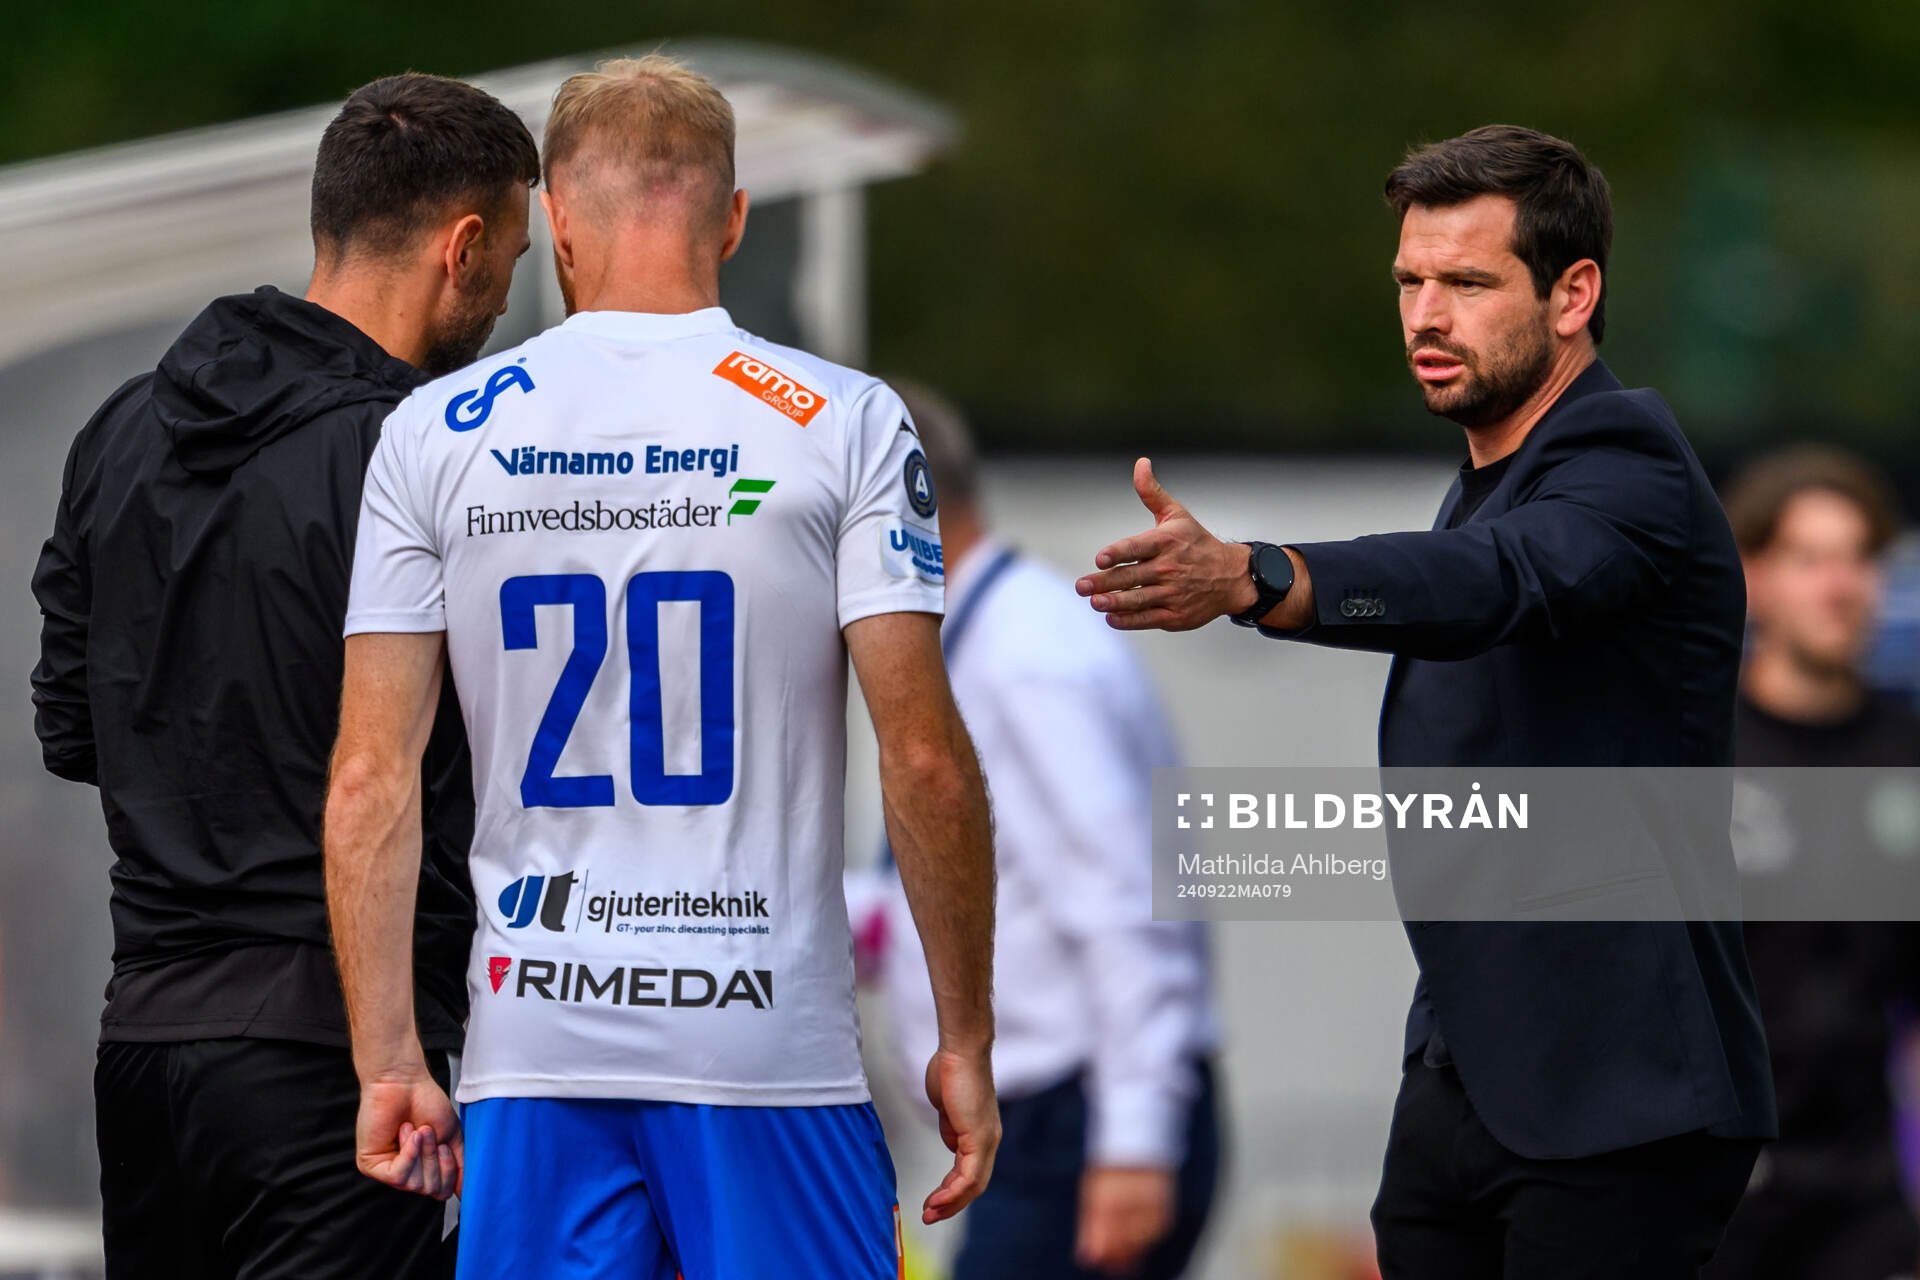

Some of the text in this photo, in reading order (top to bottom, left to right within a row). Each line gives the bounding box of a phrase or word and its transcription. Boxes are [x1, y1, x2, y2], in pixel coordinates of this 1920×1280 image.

[728, 355, 815, 410] ramo
[762, 390, 804, 418] GROUP
[490, 444, 740, 478] Värnamo Energi
[466, 497, 722, 537] Finnvedsbostäder
[500, 570, 735, 809] 20
[587, 891, 770, 933] gjuteriteknik
[634, 924, 654, 935] your
[656, 923, 676, 934] zinc
[678, 924, 726, 937] diecasting
[516, 958, 767, 1009] RIMEDA
